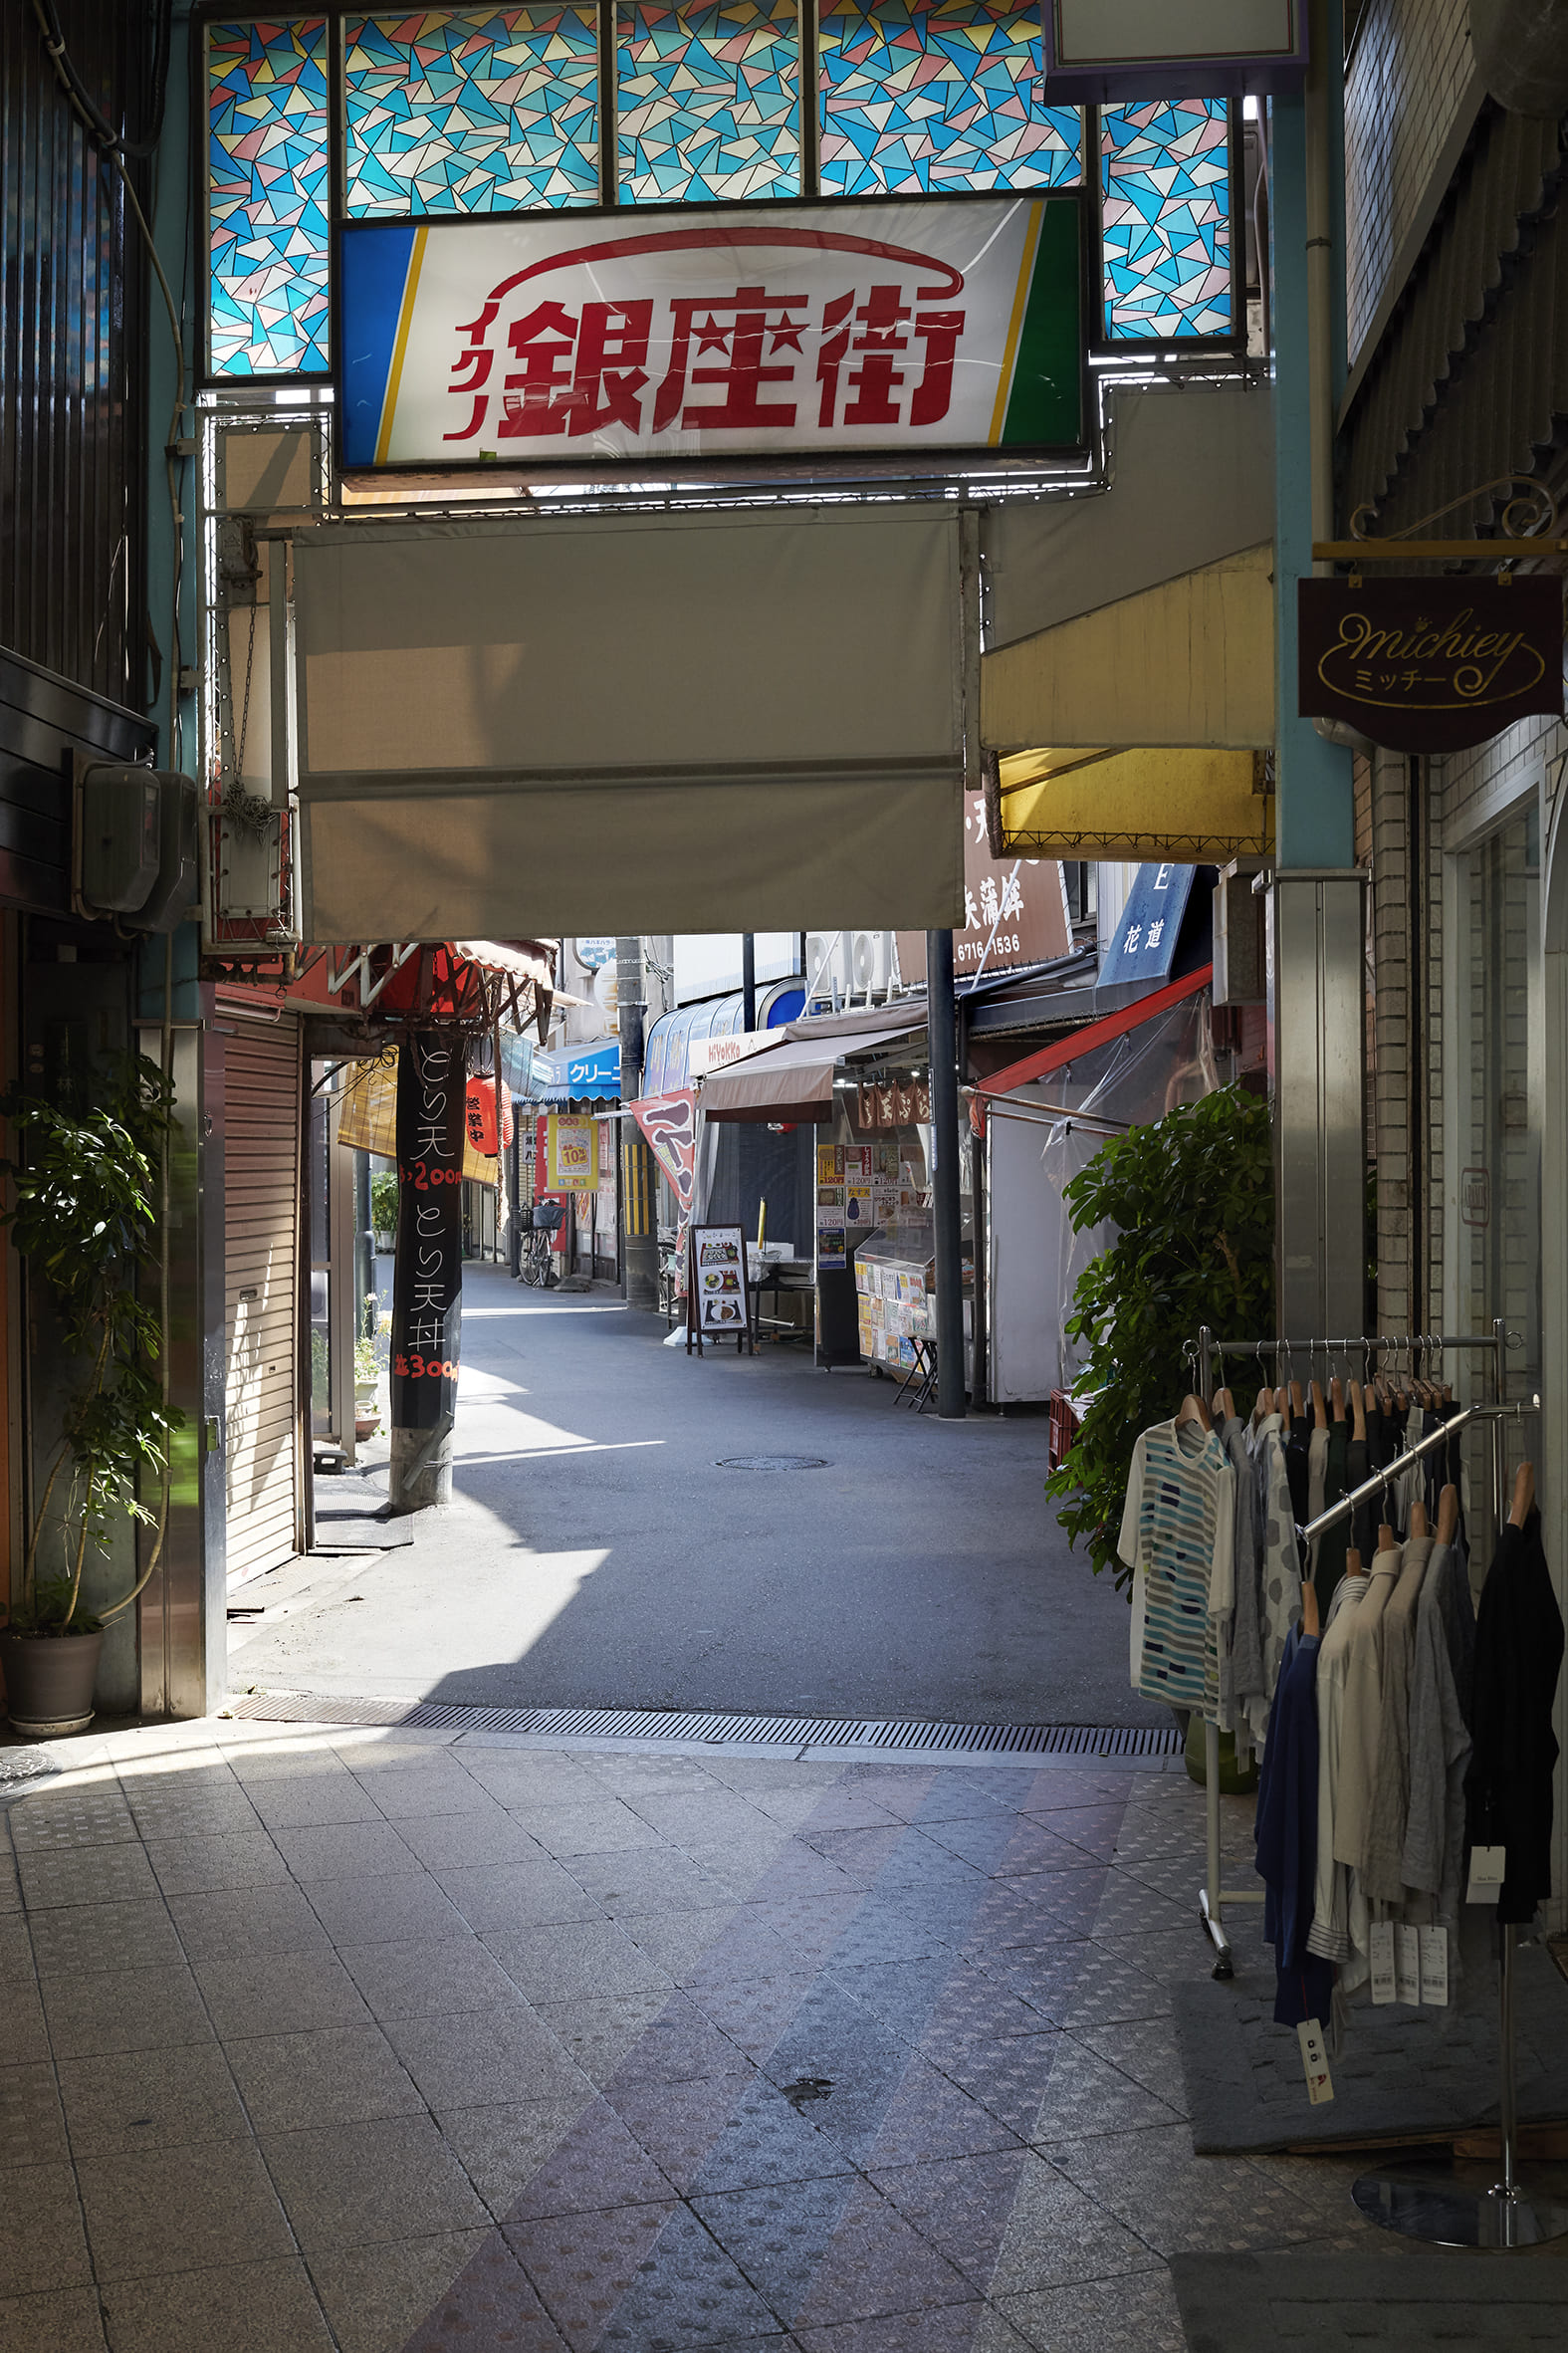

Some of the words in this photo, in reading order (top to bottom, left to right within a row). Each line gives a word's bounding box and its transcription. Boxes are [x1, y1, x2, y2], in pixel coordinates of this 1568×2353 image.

[499, 286, 965, 436] 銀座街
[1355, 668, 1447, 692] ミッチー
[1123, 918, 1165, 955] 花道
